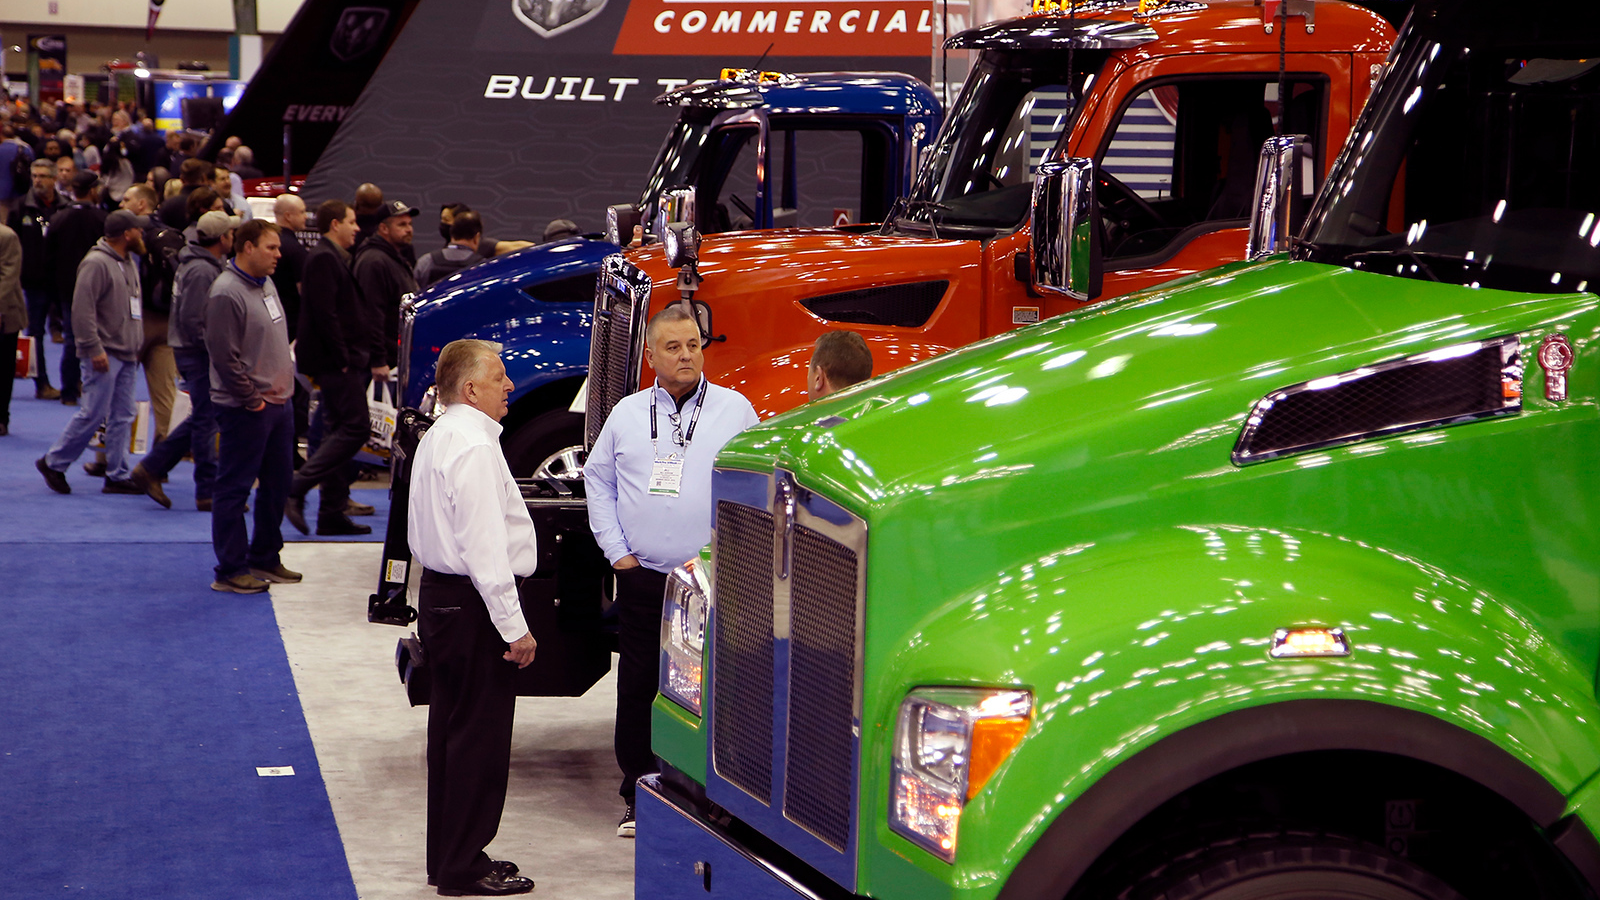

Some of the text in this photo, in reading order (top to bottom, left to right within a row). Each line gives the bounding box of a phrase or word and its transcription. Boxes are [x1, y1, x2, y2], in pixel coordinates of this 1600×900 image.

[653, 9, 932, 34] COMMERCIAL
[484, 74, 719, 102] BUILT T
[282, 104, 350, 121] EVERY
